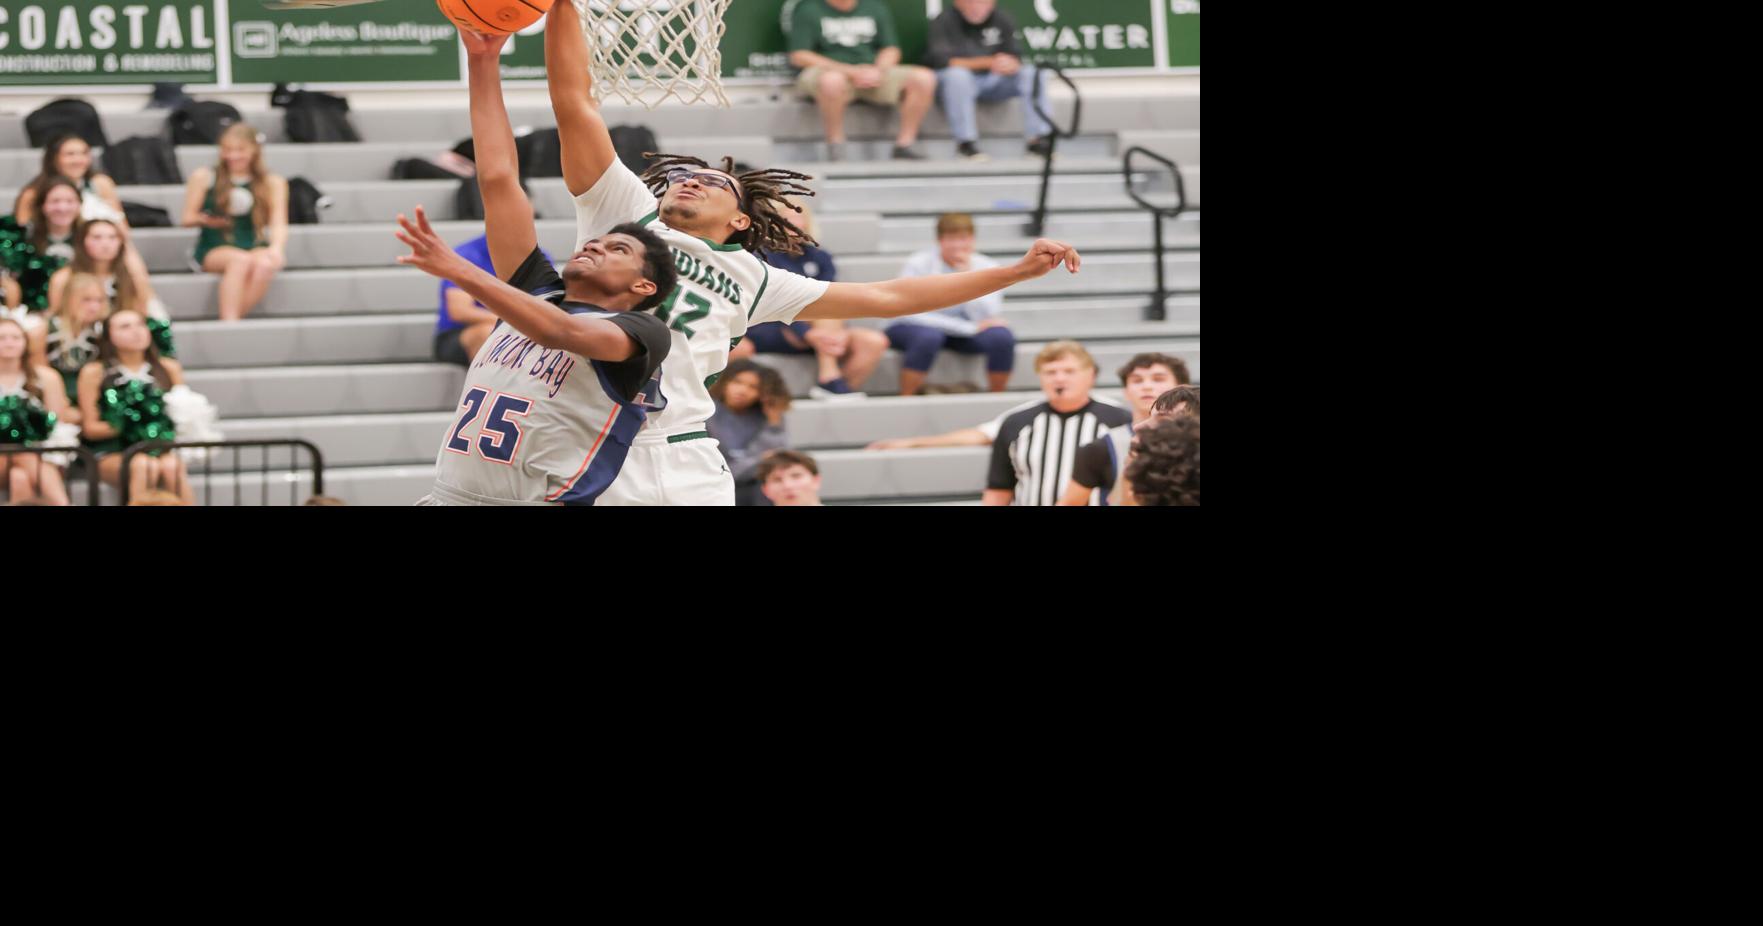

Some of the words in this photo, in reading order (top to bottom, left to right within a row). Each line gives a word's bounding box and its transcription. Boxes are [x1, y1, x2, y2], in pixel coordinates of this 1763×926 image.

[1013, 24, 1149, 50] WATER
[103, 53, 119, 72] &
[120, 53, 214, 72] REMODELING
[446, 385, 534, 465] 25
